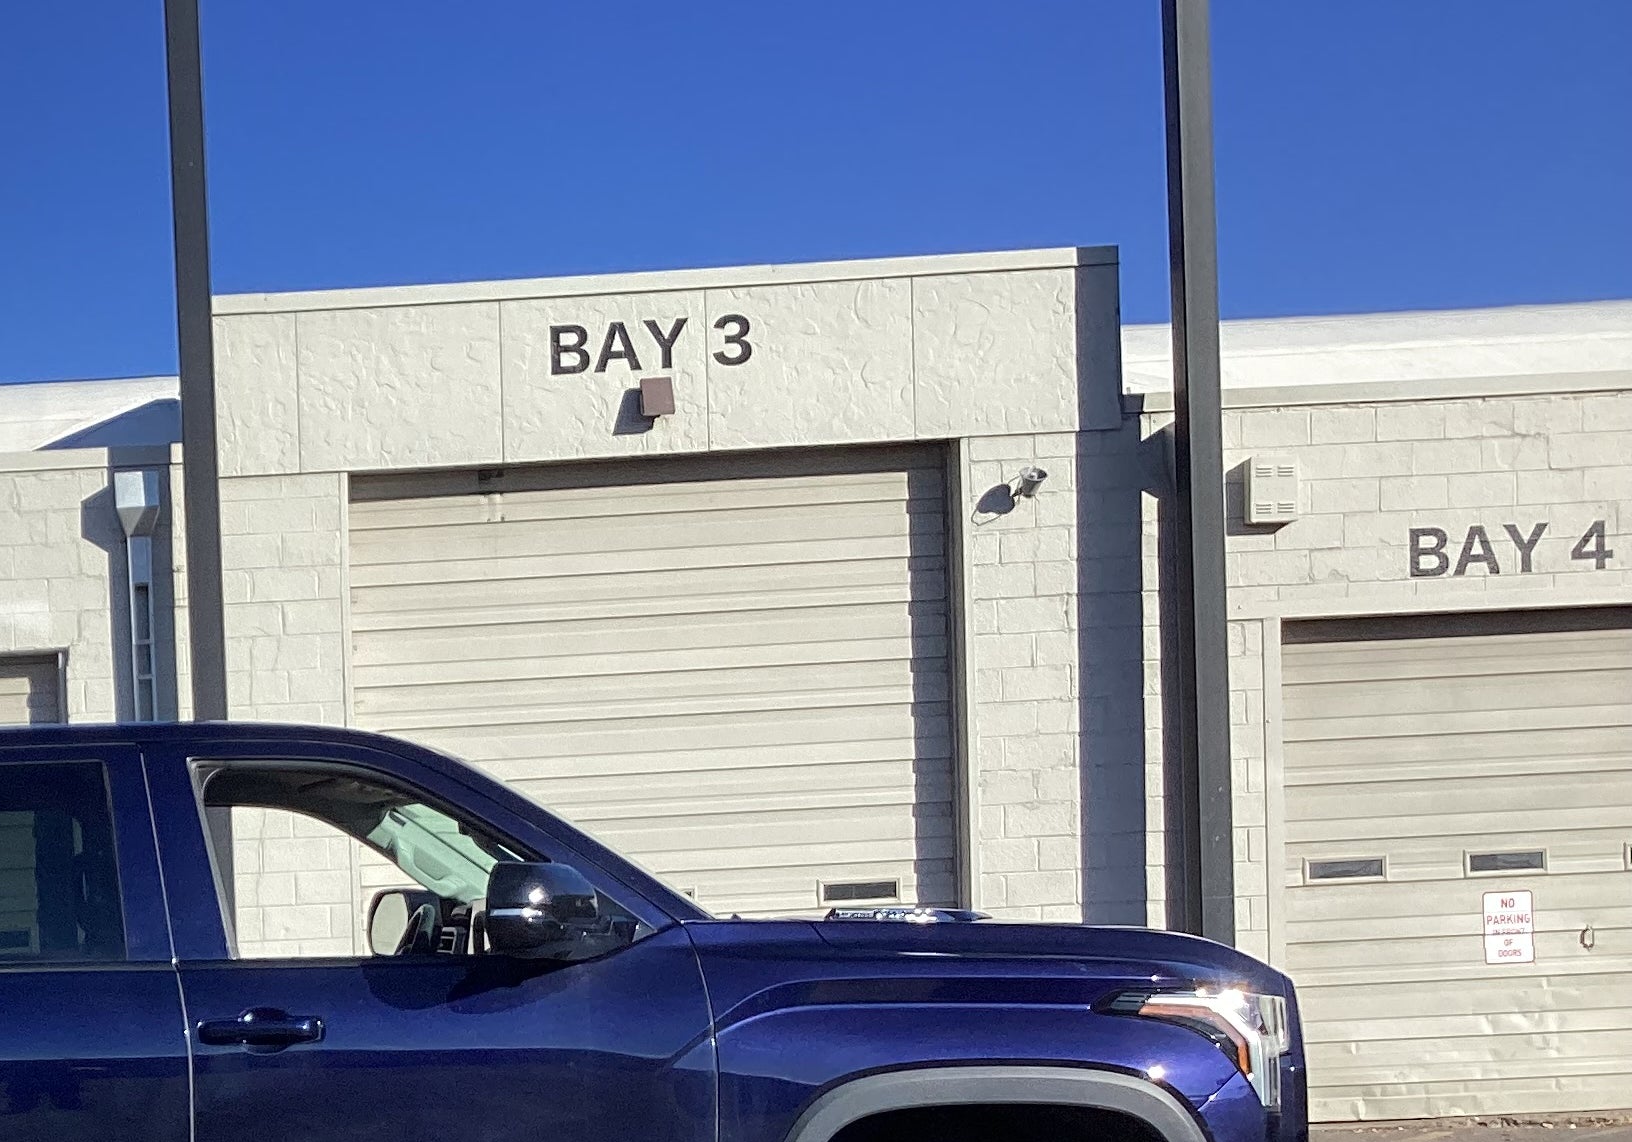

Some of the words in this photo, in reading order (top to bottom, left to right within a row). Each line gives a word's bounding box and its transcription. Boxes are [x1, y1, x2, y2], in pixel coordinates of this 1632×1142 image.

[549, 317, 689, 375] BAY
[712, 314, 753, 366] 3
[1409, 522, 1550, 577] BAY
[1570, 520, 1614, 570] 4
[1500, 898, 1515, 909] NO
[1486, 913, 1531, 926] PARKING
[1503, 938, 1514, 947] OF
[1497, 949, 1522, 958] DOORS
